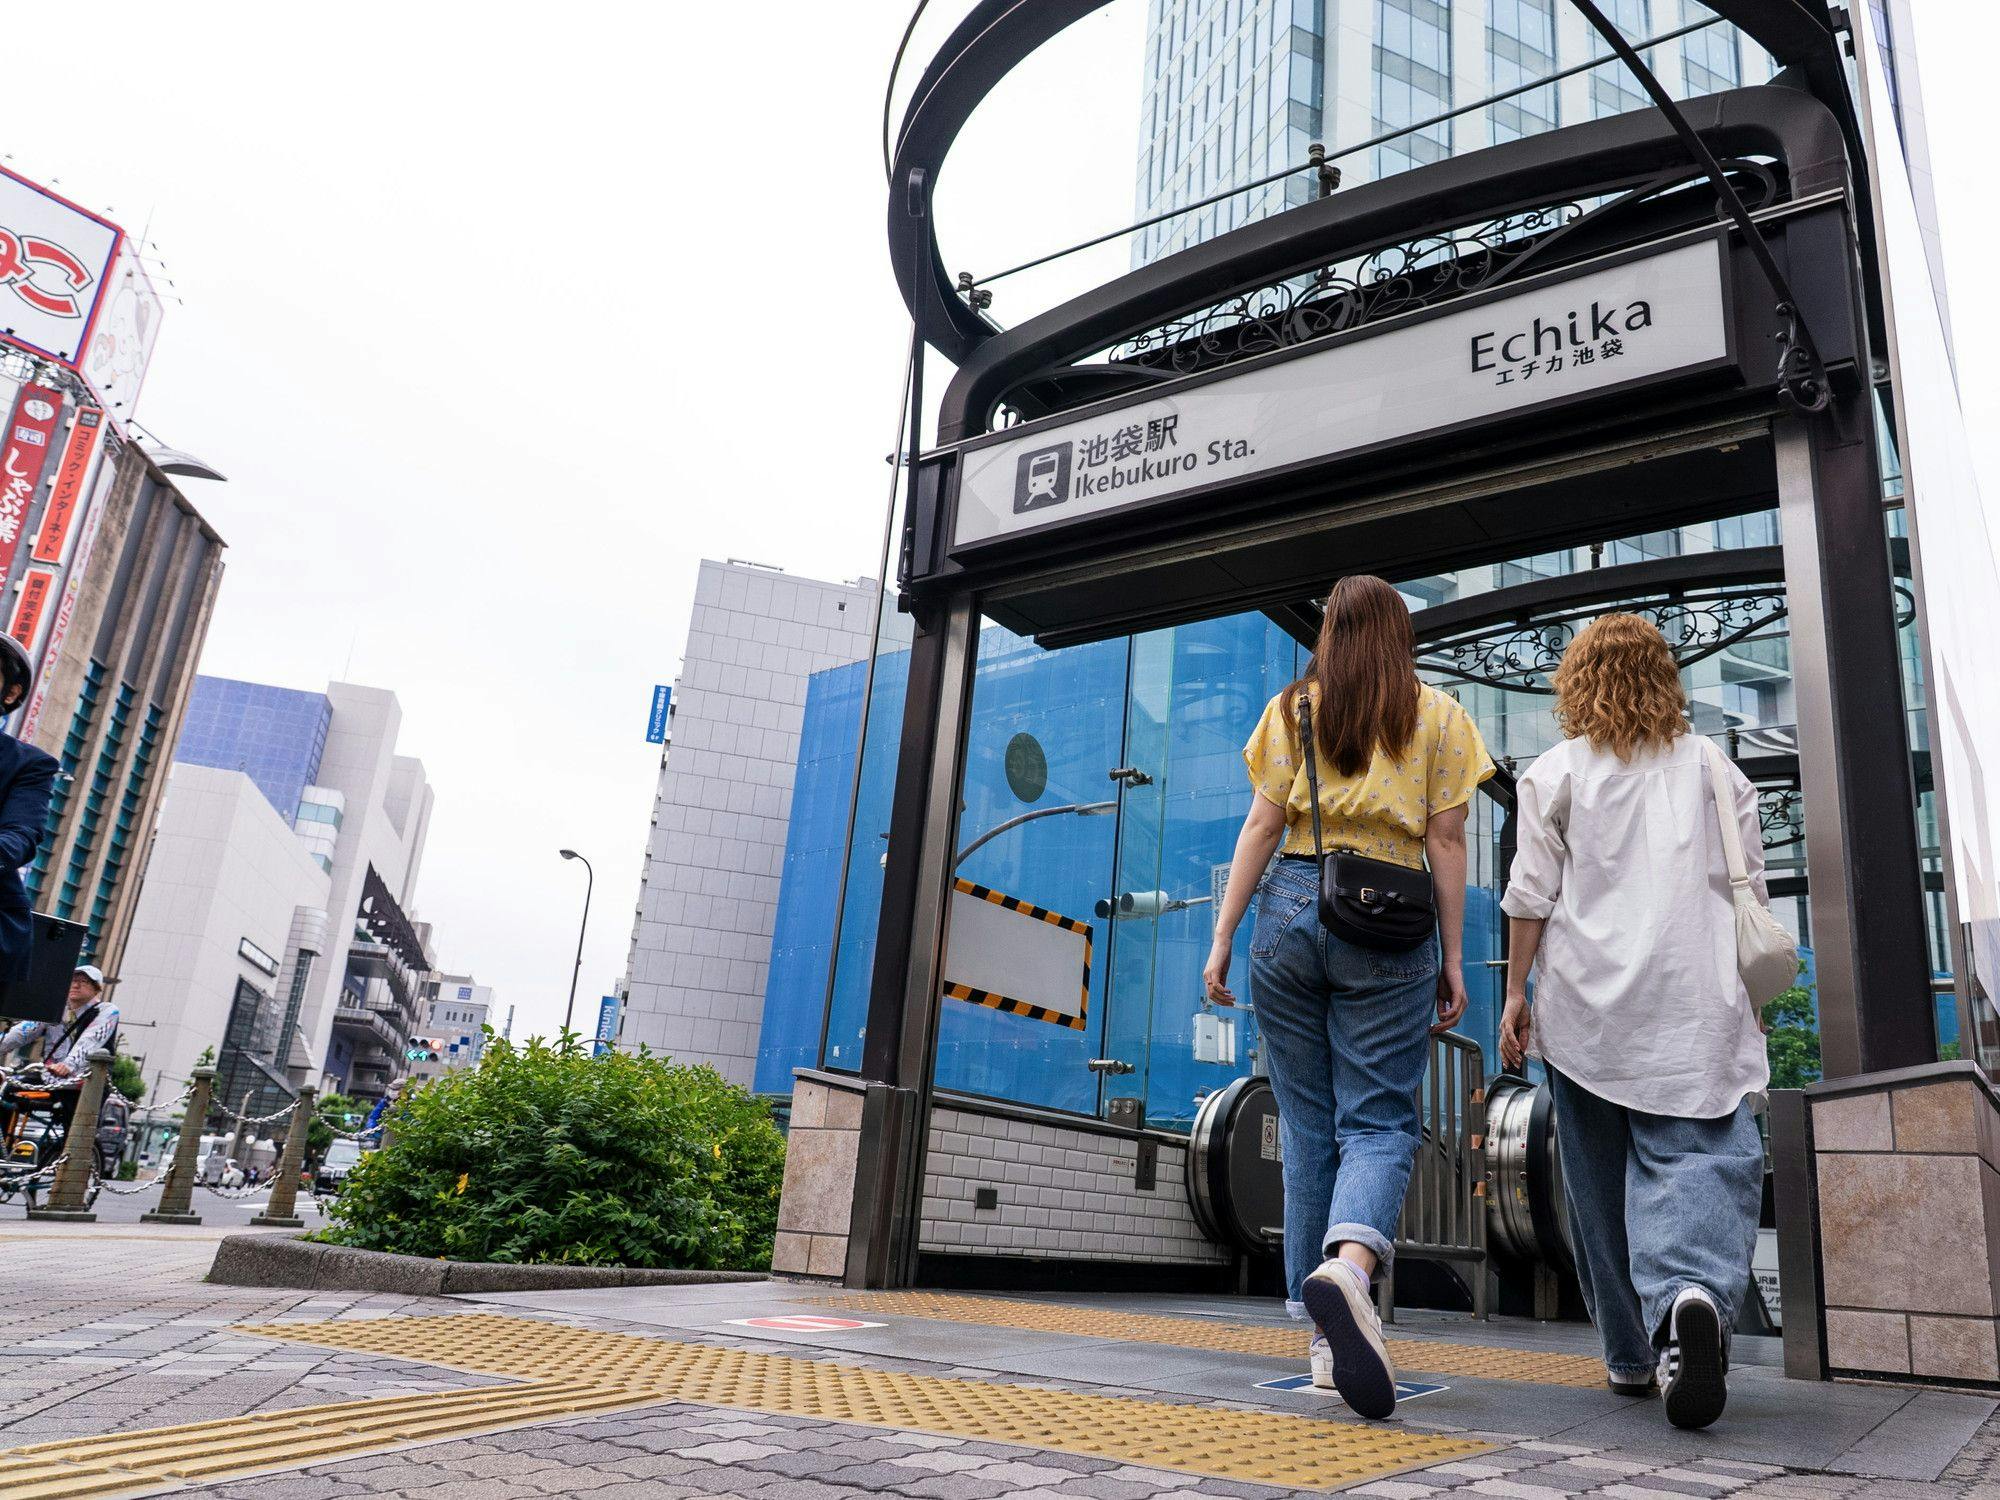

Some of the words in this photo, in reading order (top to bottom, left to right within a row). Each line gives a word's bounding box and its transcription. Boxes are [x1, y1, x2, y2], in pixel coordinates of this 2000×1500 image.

[1471, 300, 1652, 373] Echika
[1074, 452, 1198, 499] Ikebukuro
[1207, 439, 1256, 466] Sta.
[1077, 414, 1180, 471] 池袋駅
